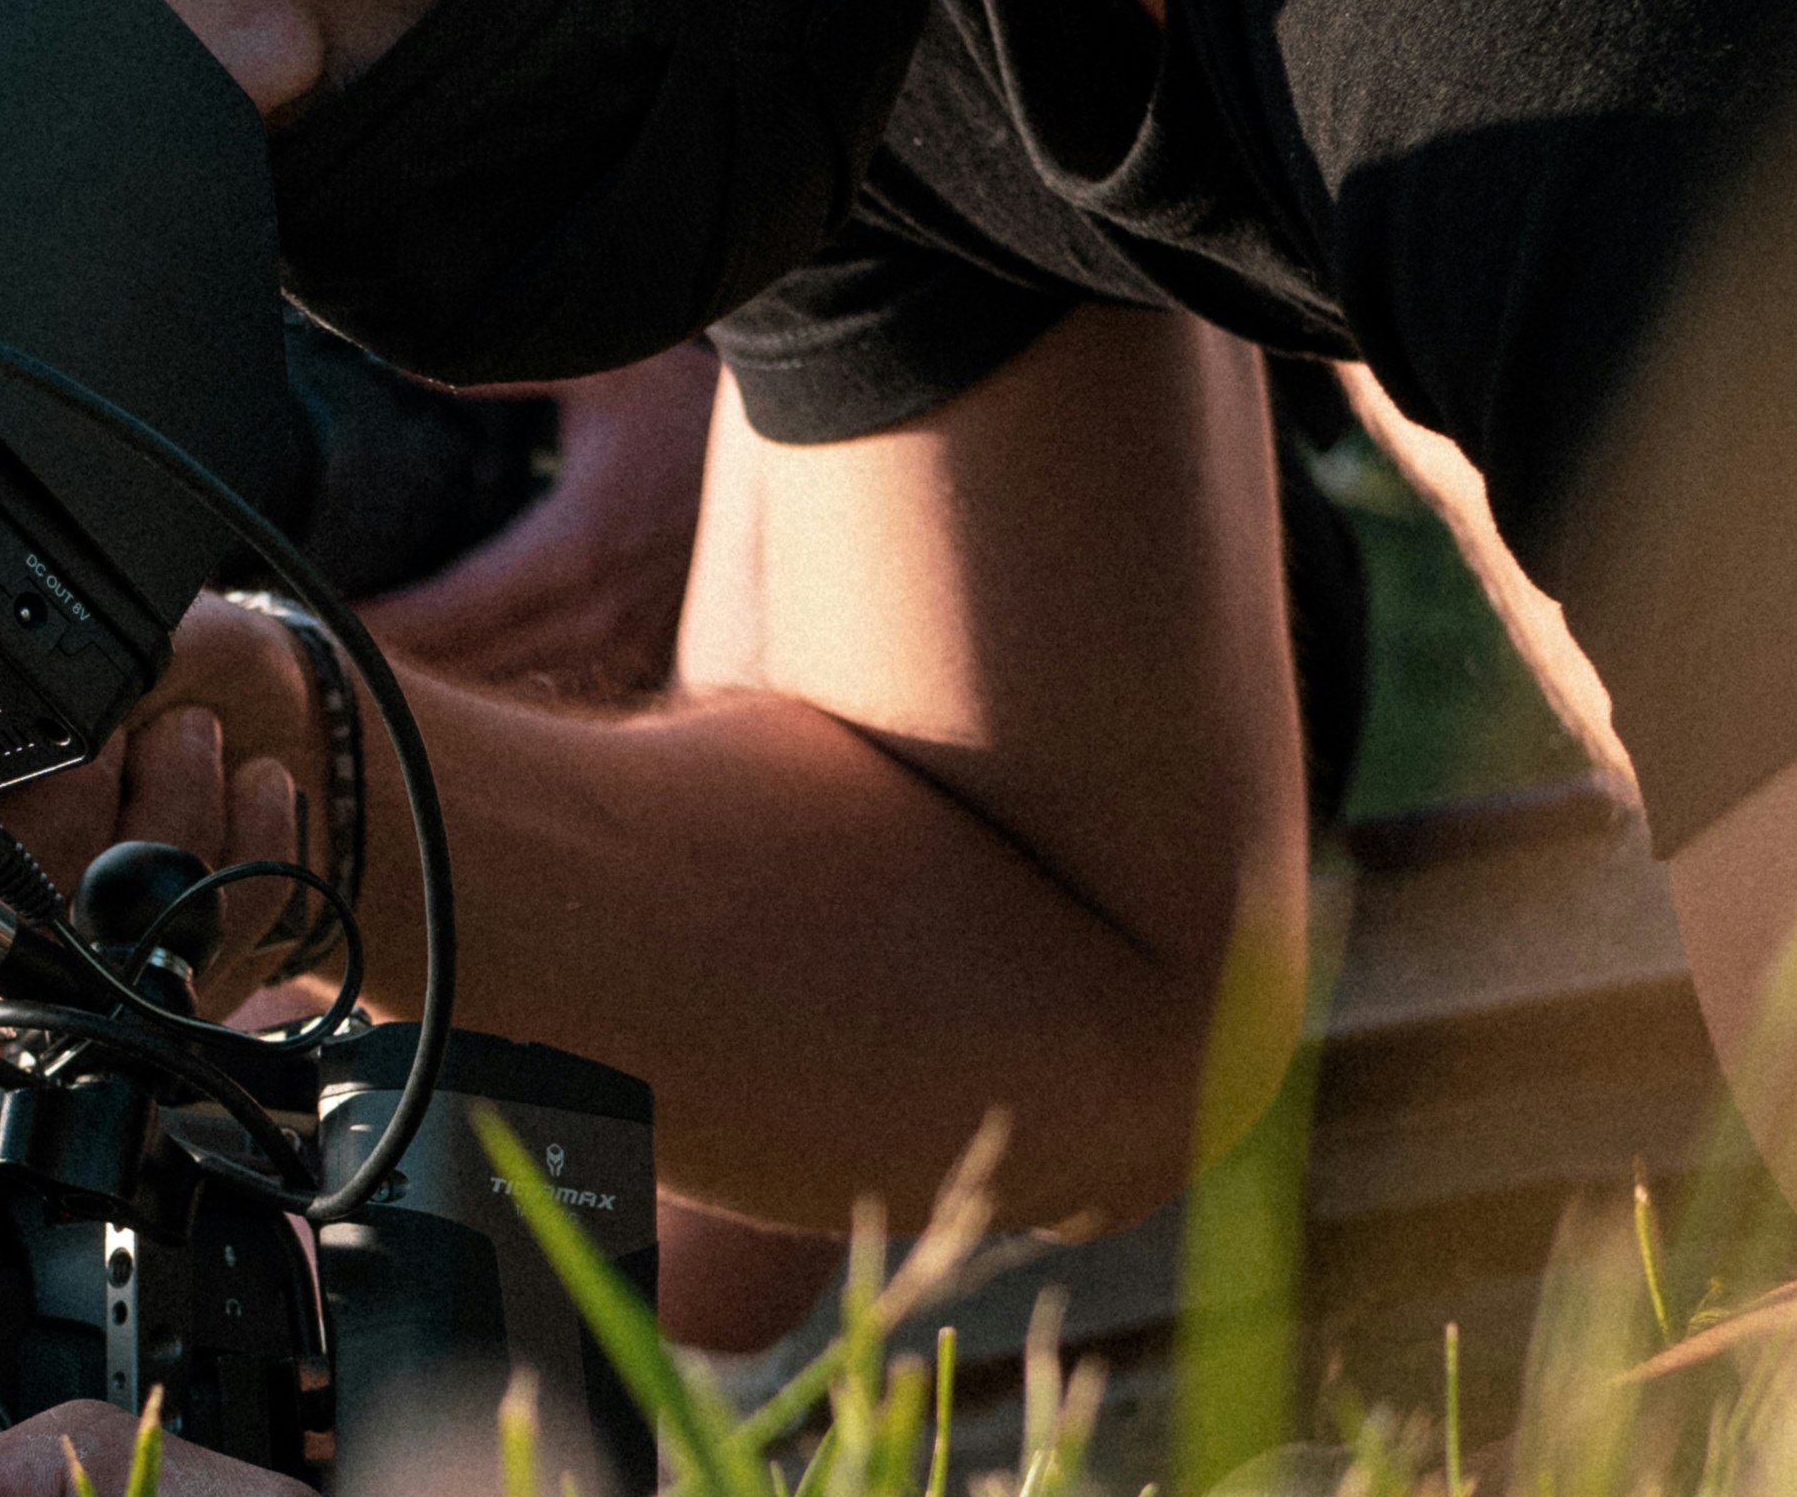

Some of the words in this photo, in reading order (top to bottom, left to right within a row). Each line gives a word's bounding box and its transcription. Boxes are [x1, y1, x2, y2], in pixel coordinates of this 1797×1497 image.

[26, 553, 47, 577] DC
[46, 574, 75, 603] OUT
[71, 602, 91, 622] 8V
